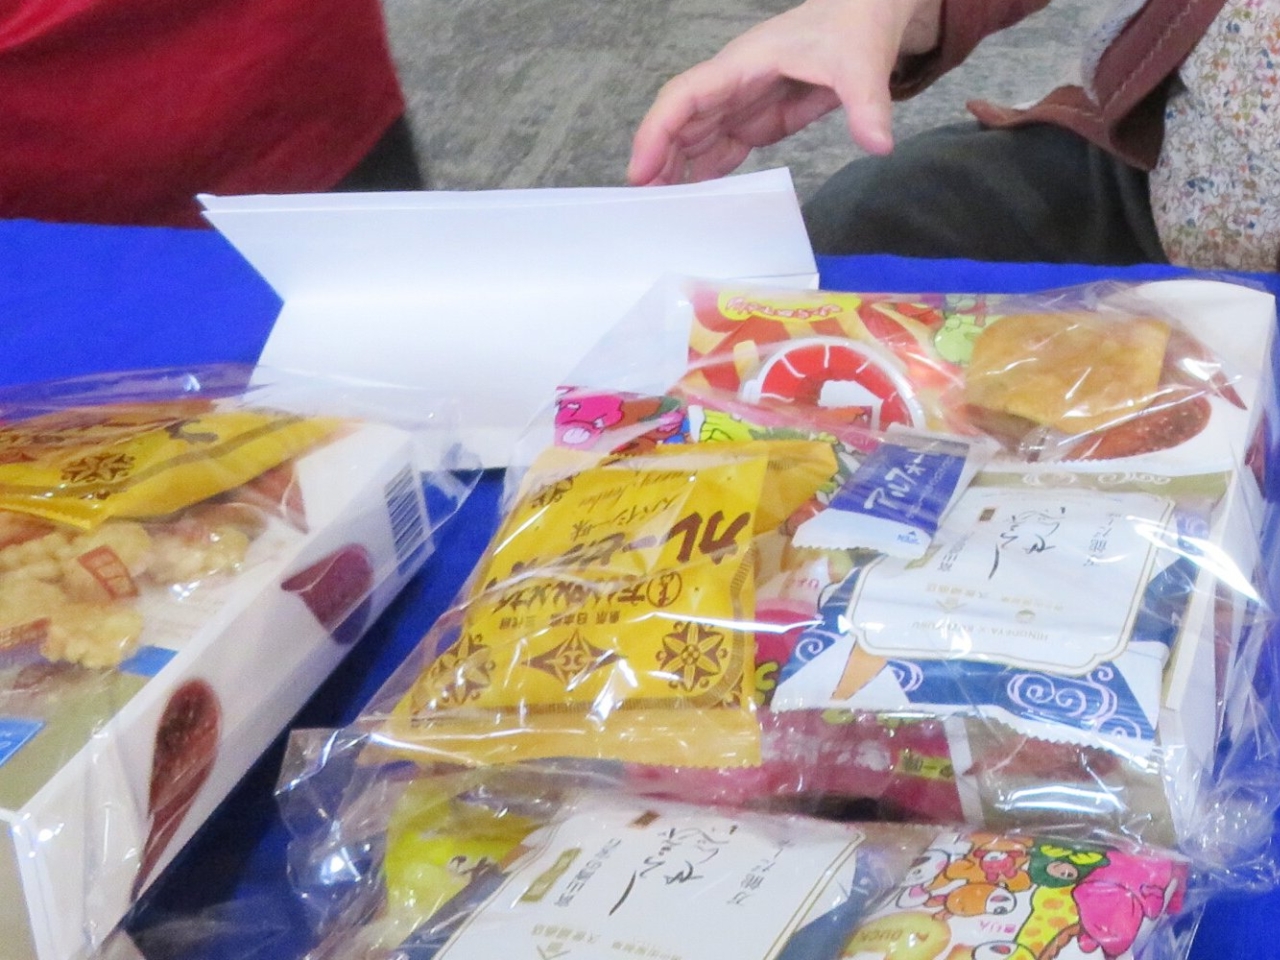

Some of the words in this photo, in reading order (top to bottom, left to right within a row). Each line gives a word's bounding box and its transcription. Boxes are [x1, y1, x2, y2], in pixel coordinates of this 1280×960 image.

[863, 453, 928, 515] アルフォー
